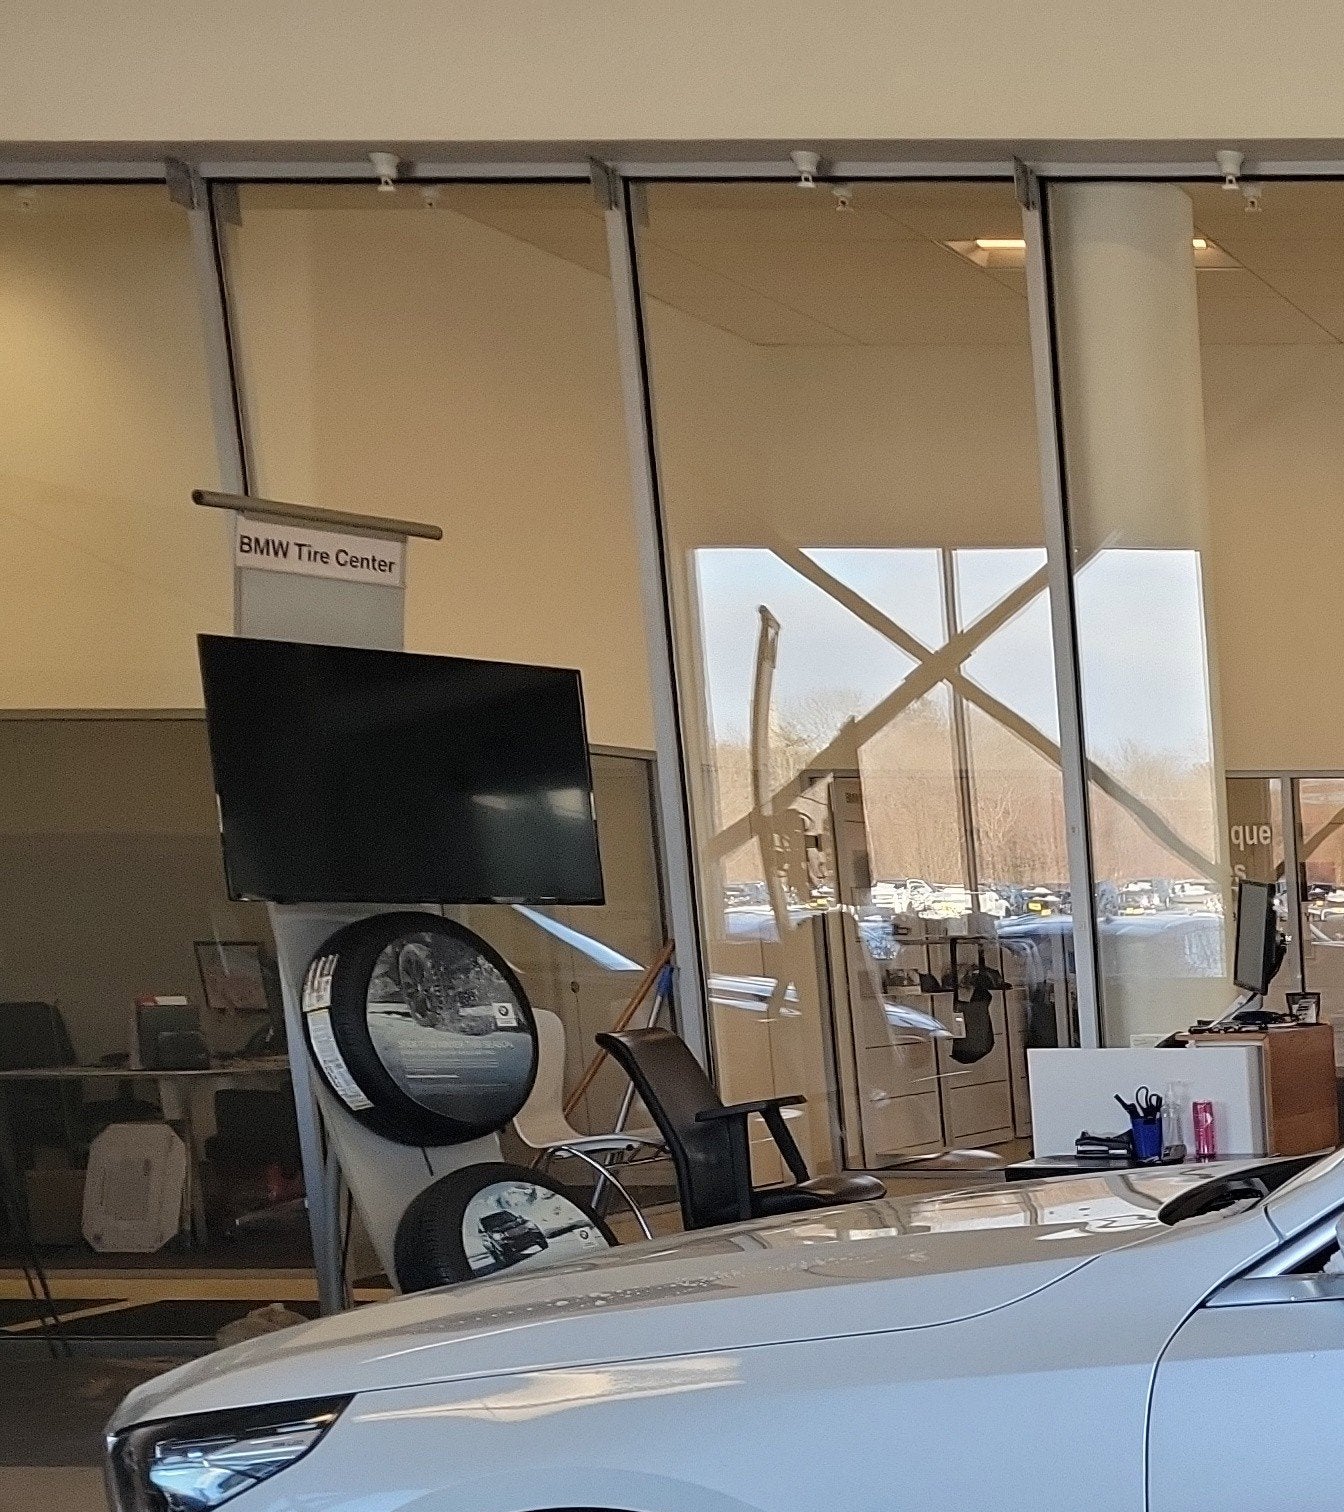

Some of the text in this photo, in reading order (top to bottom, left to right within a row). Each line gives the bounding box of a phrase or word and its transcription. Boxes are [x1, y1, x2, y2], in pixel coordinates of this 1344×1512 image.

[239, 534, 396, 573] BMW Tire Center
